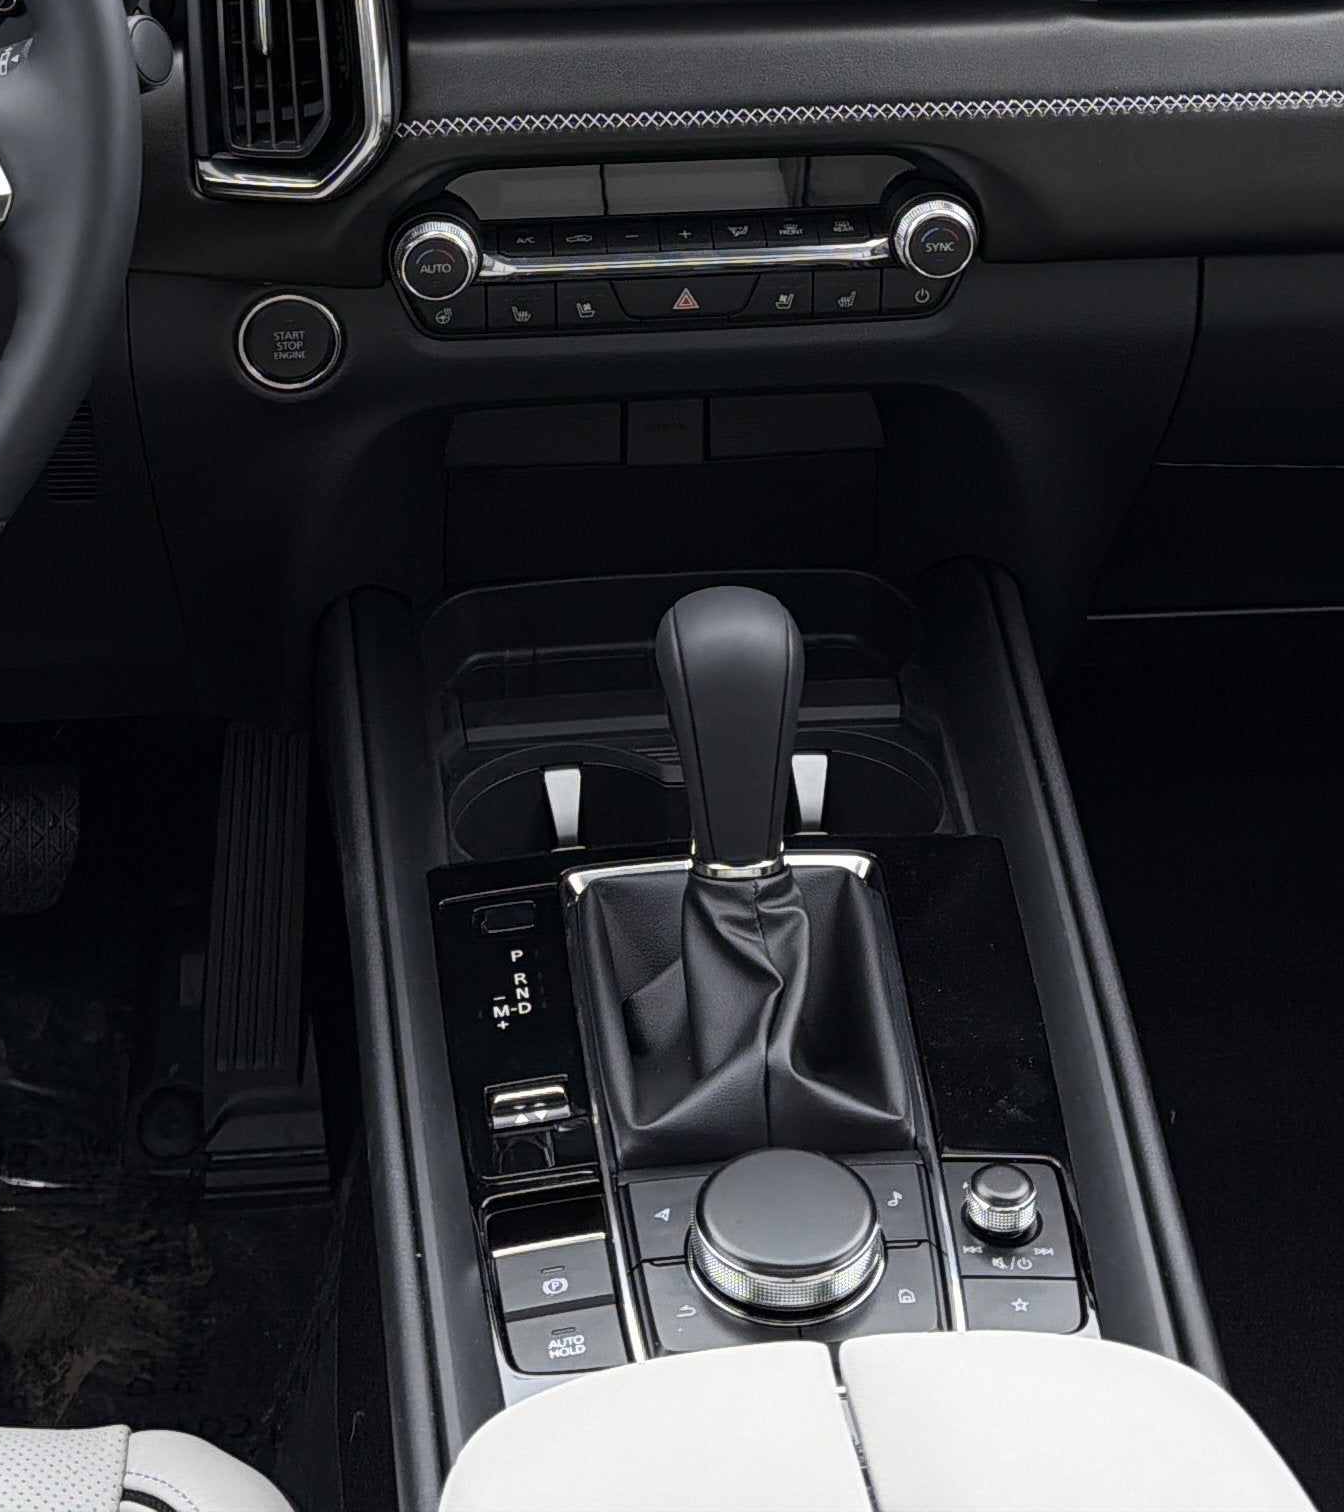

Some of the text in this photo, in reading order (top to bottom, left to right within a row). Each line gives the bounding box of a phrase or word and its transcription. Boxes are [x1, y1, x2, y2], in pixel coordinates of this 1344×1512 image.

[925, 241, 955, 253] SYNC
[419, 263, 452, 274] AUTO
[273, 330, 306, 341] START
[276, 340, 304, 351] STOP
[273, 350, 307, 360] ENGINE
[510, 949, 524, 963] P
[513, 972, 528, 986] R
[515, 986, 530, 1000] N
[548, 1334, 585, 1350] AUTO
[548, 1344, 587, 1359] HOLD
